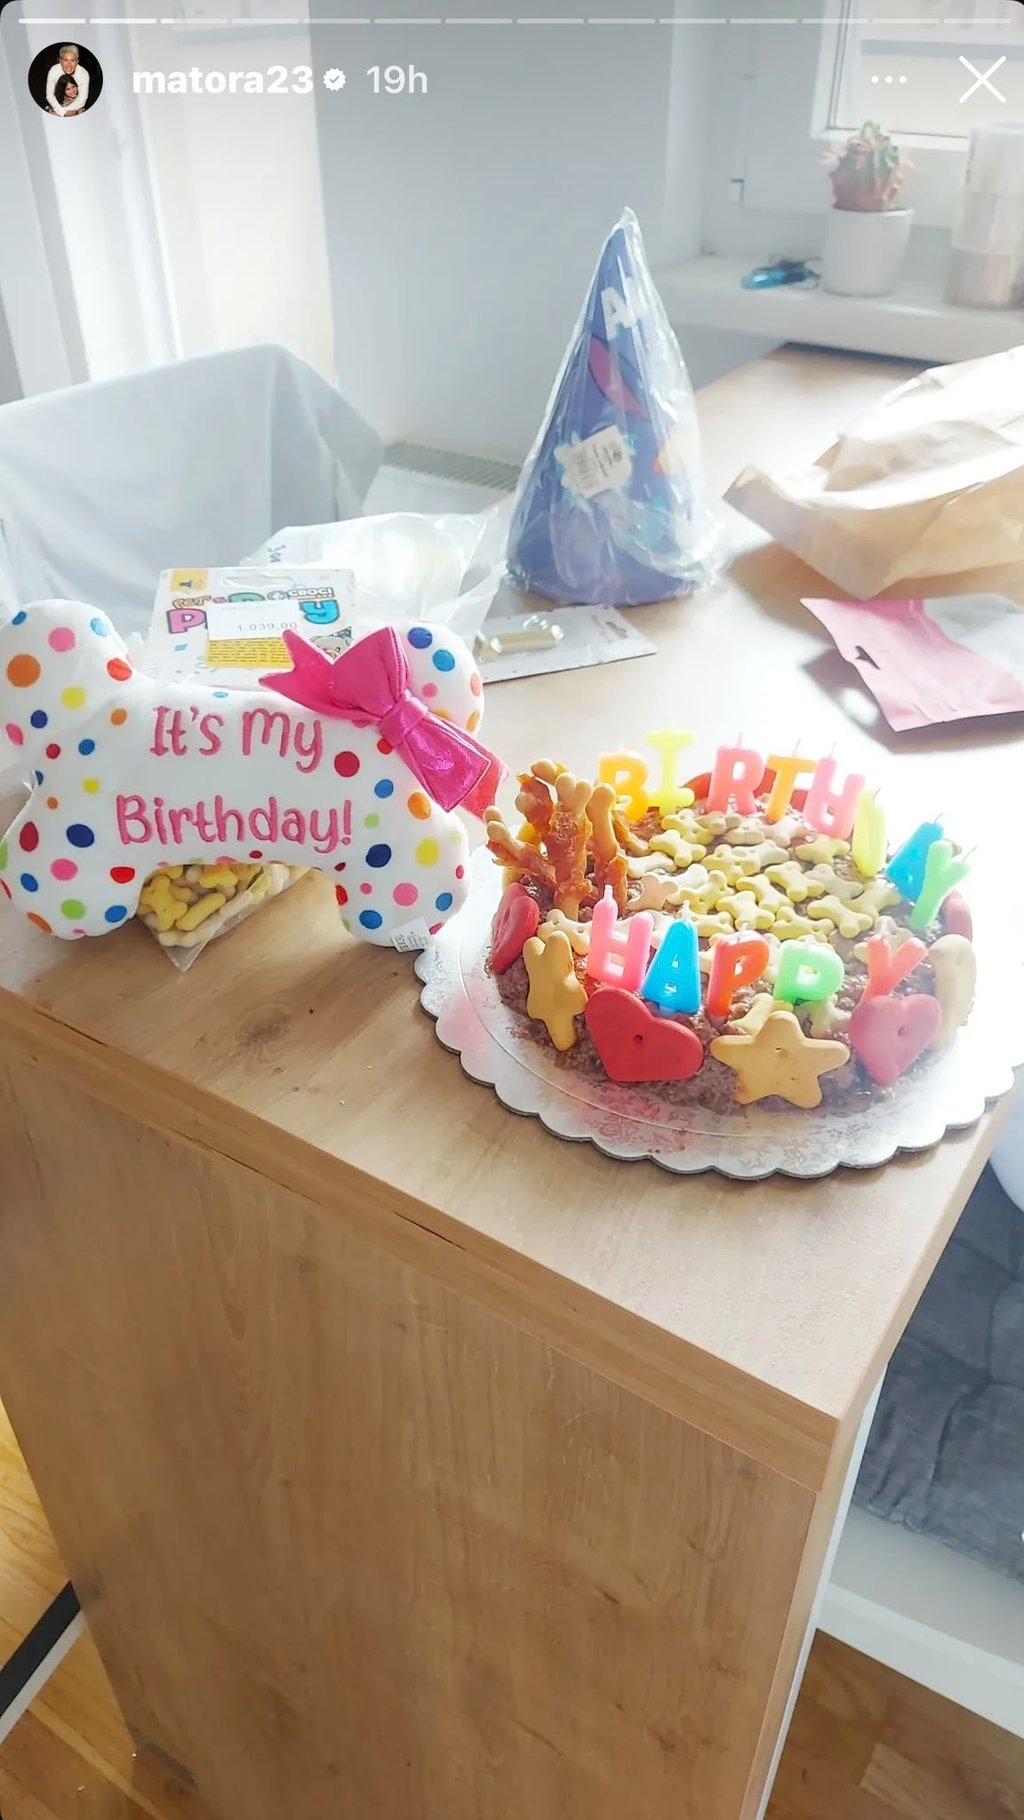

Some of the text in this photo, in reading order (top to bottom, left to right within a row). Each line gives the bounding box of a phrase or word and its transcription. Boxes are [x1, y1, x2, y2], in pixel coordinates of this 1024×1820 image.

[149, 706, 324, 773] It's My
[115, 794, 352, 853] Birthday!
[587, 893, 928, 1018] HAPPY
